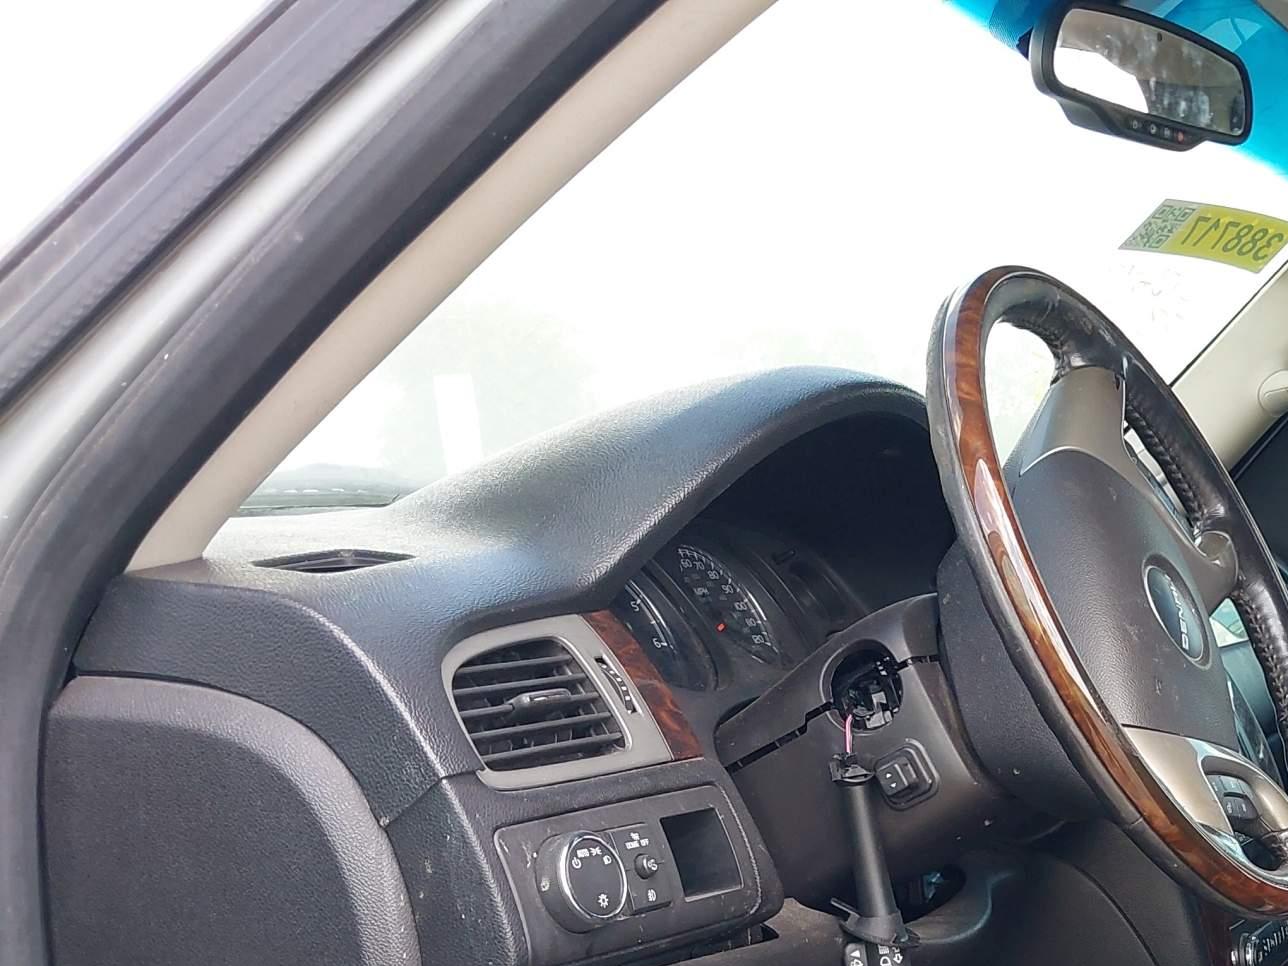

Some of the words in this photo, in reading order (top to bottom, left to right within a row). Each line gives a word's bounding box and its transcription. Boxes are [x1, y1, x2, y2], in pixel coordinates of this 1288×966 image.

[693, 561, 705, 570] 70
[707, 570, 720, 580] 80
[721, 584, 734, 594] 90
[630, 601, 640, 612] 5
[652, 637, 662, 649] 6
